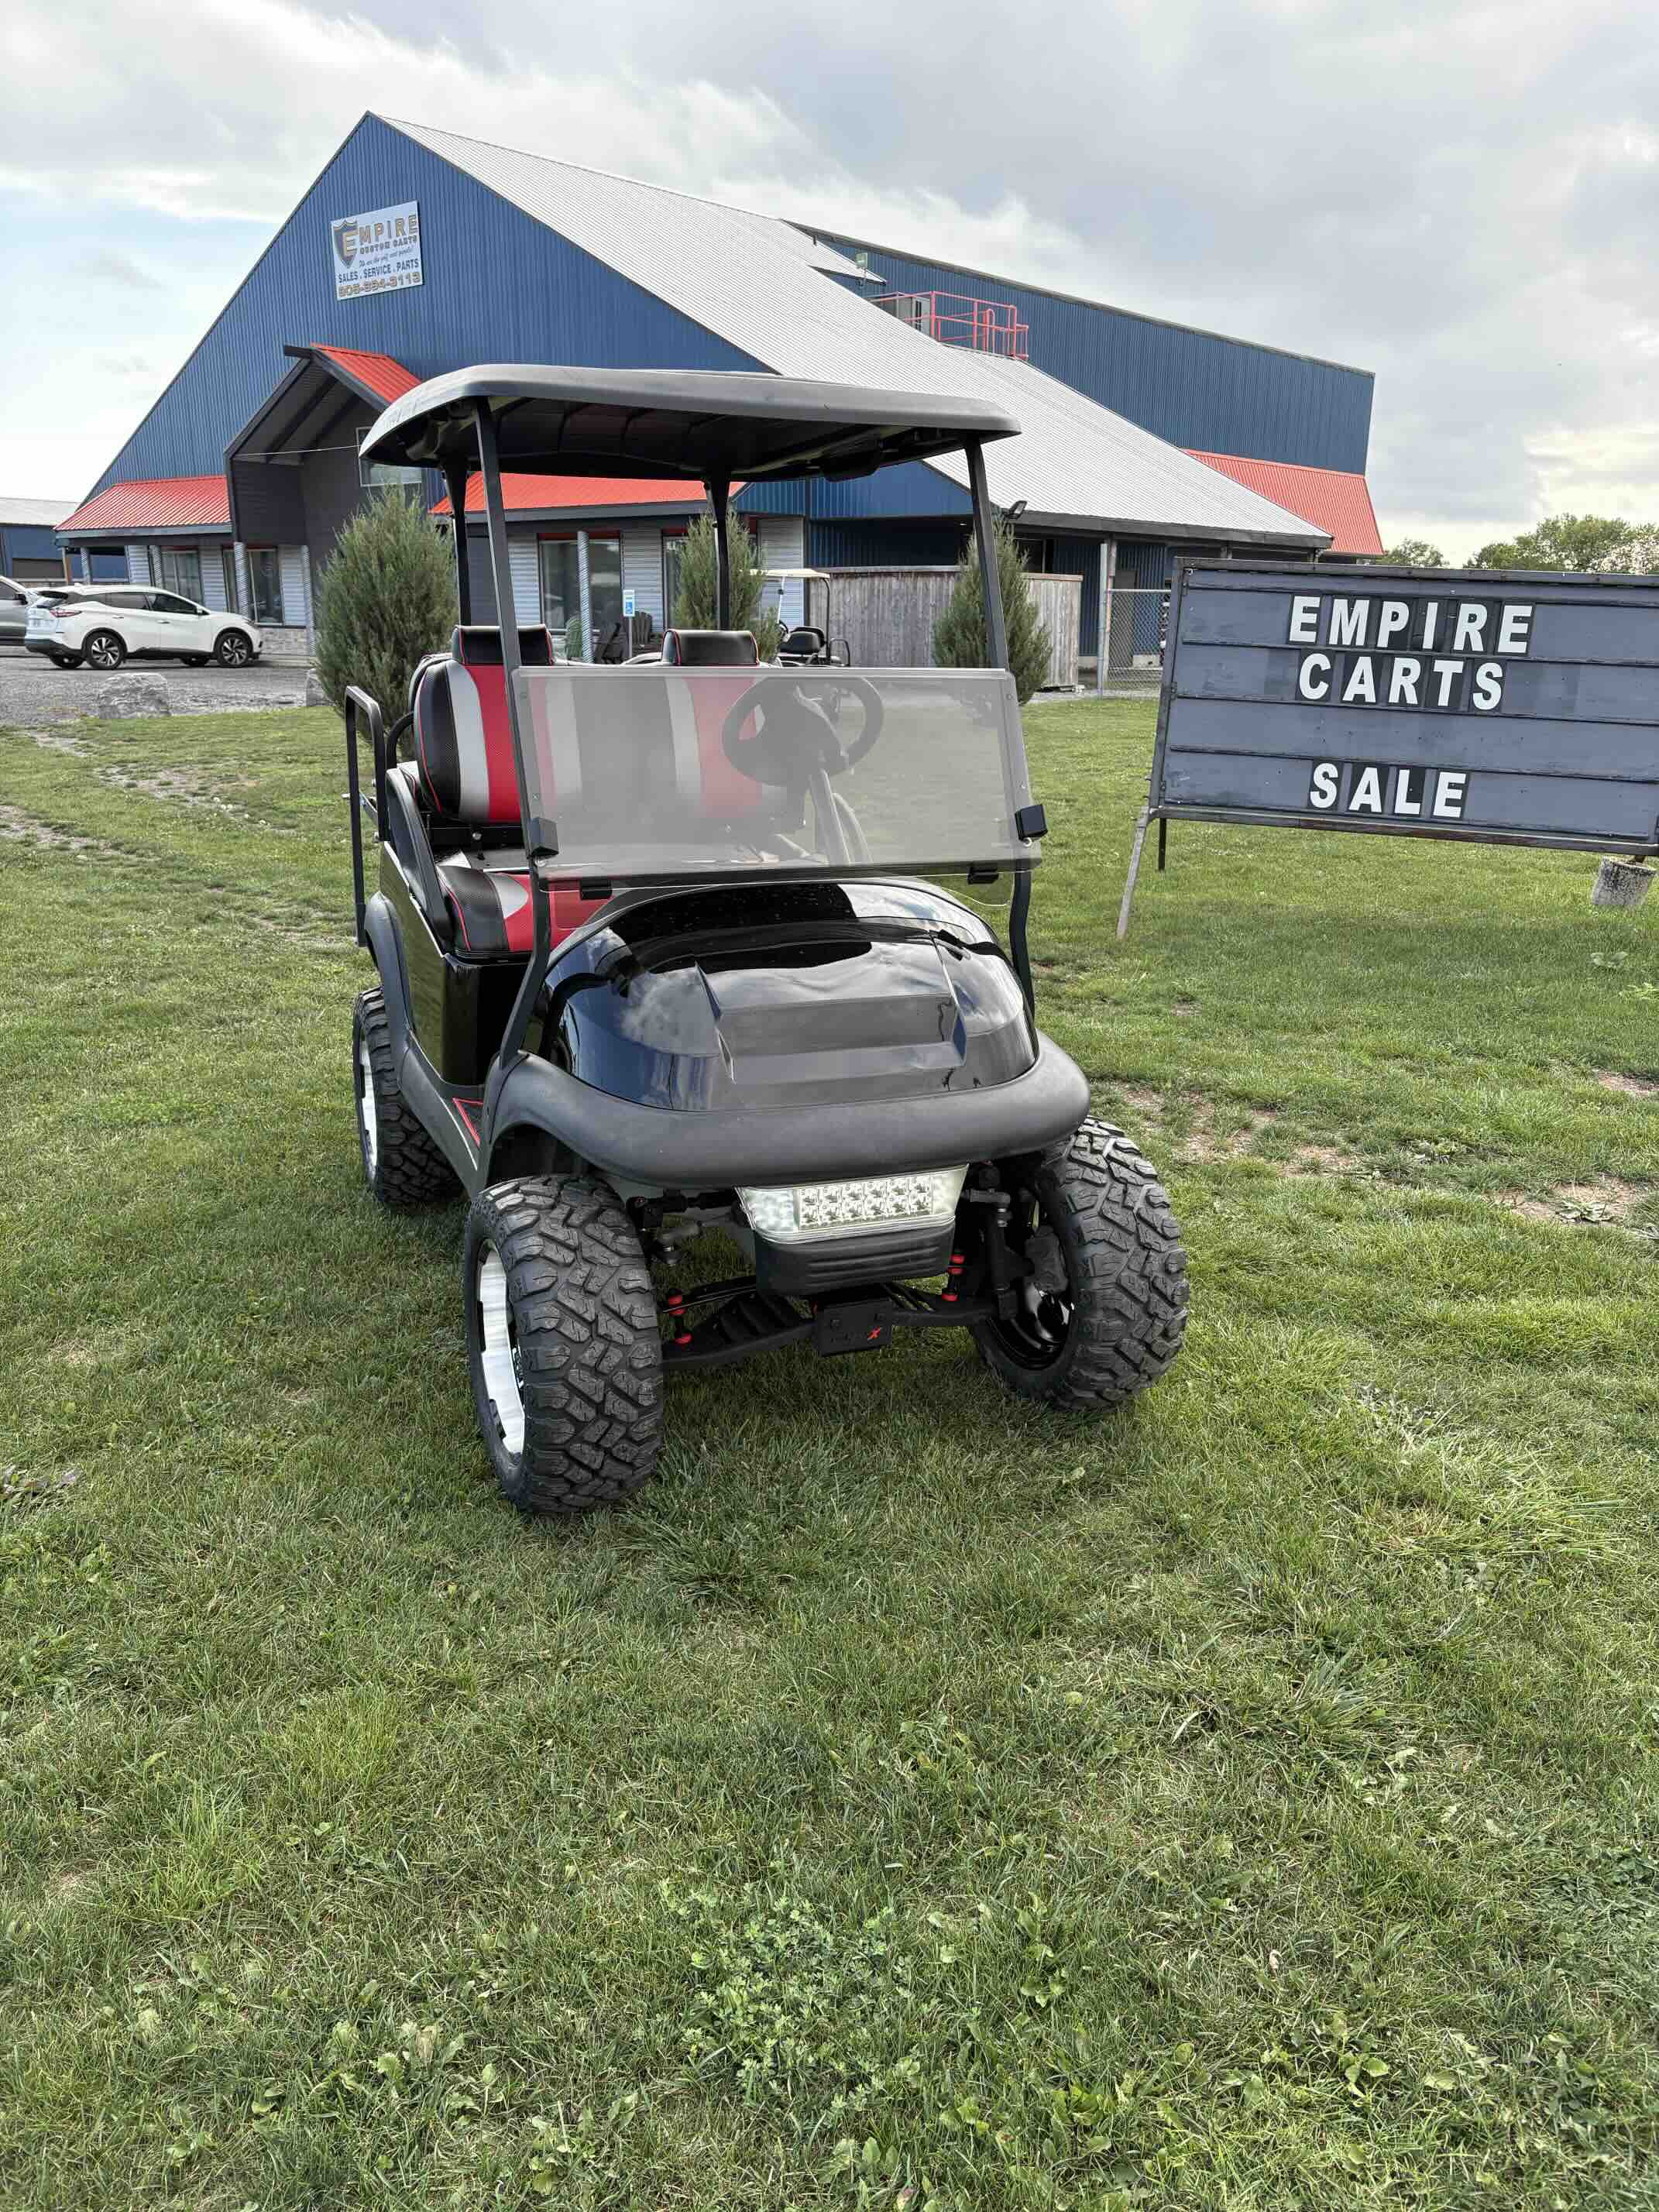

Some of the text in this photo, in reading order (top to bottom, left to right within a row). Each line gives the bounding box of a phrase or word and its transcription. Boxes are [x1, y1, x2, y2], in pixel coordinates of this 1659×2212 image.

[343, 213, 417, 256] EMPIRE
[338, 259, 419, 283] SALES SERVICE PARTS
[1289, 596, 1533, 653] EMPIRE
[1299, 653, 1503, 710] CARTS
[1310, 763, 1466, 818] SALE
